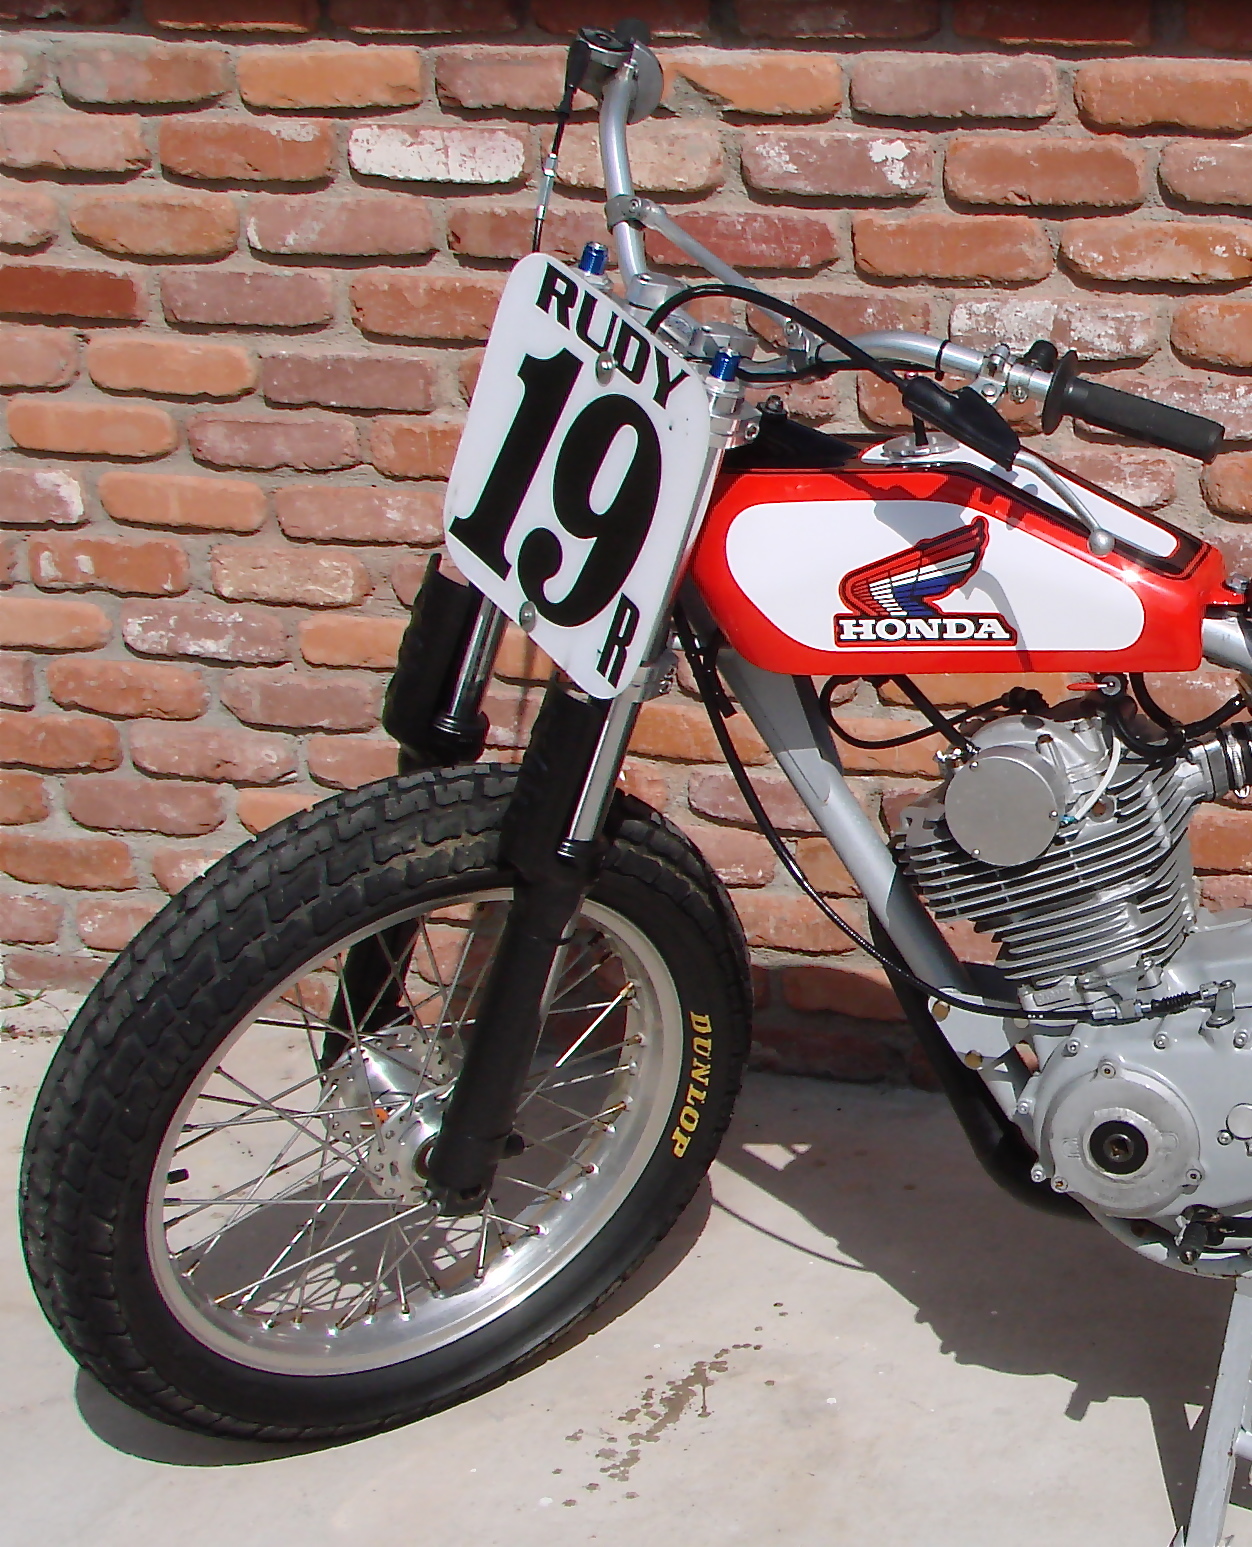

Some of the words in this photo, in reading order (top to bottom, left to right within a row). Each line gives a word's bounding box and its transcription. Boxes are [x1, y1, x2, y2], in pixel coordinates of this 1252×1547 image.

[535, 261, 690, 409] RUDY
[449, 348, 662, 626] 19
[596, 593, 640, 689] R
[838, 618, 1011, 641] HONDA
[671, 1010, 712, 1158] DUNLOP
